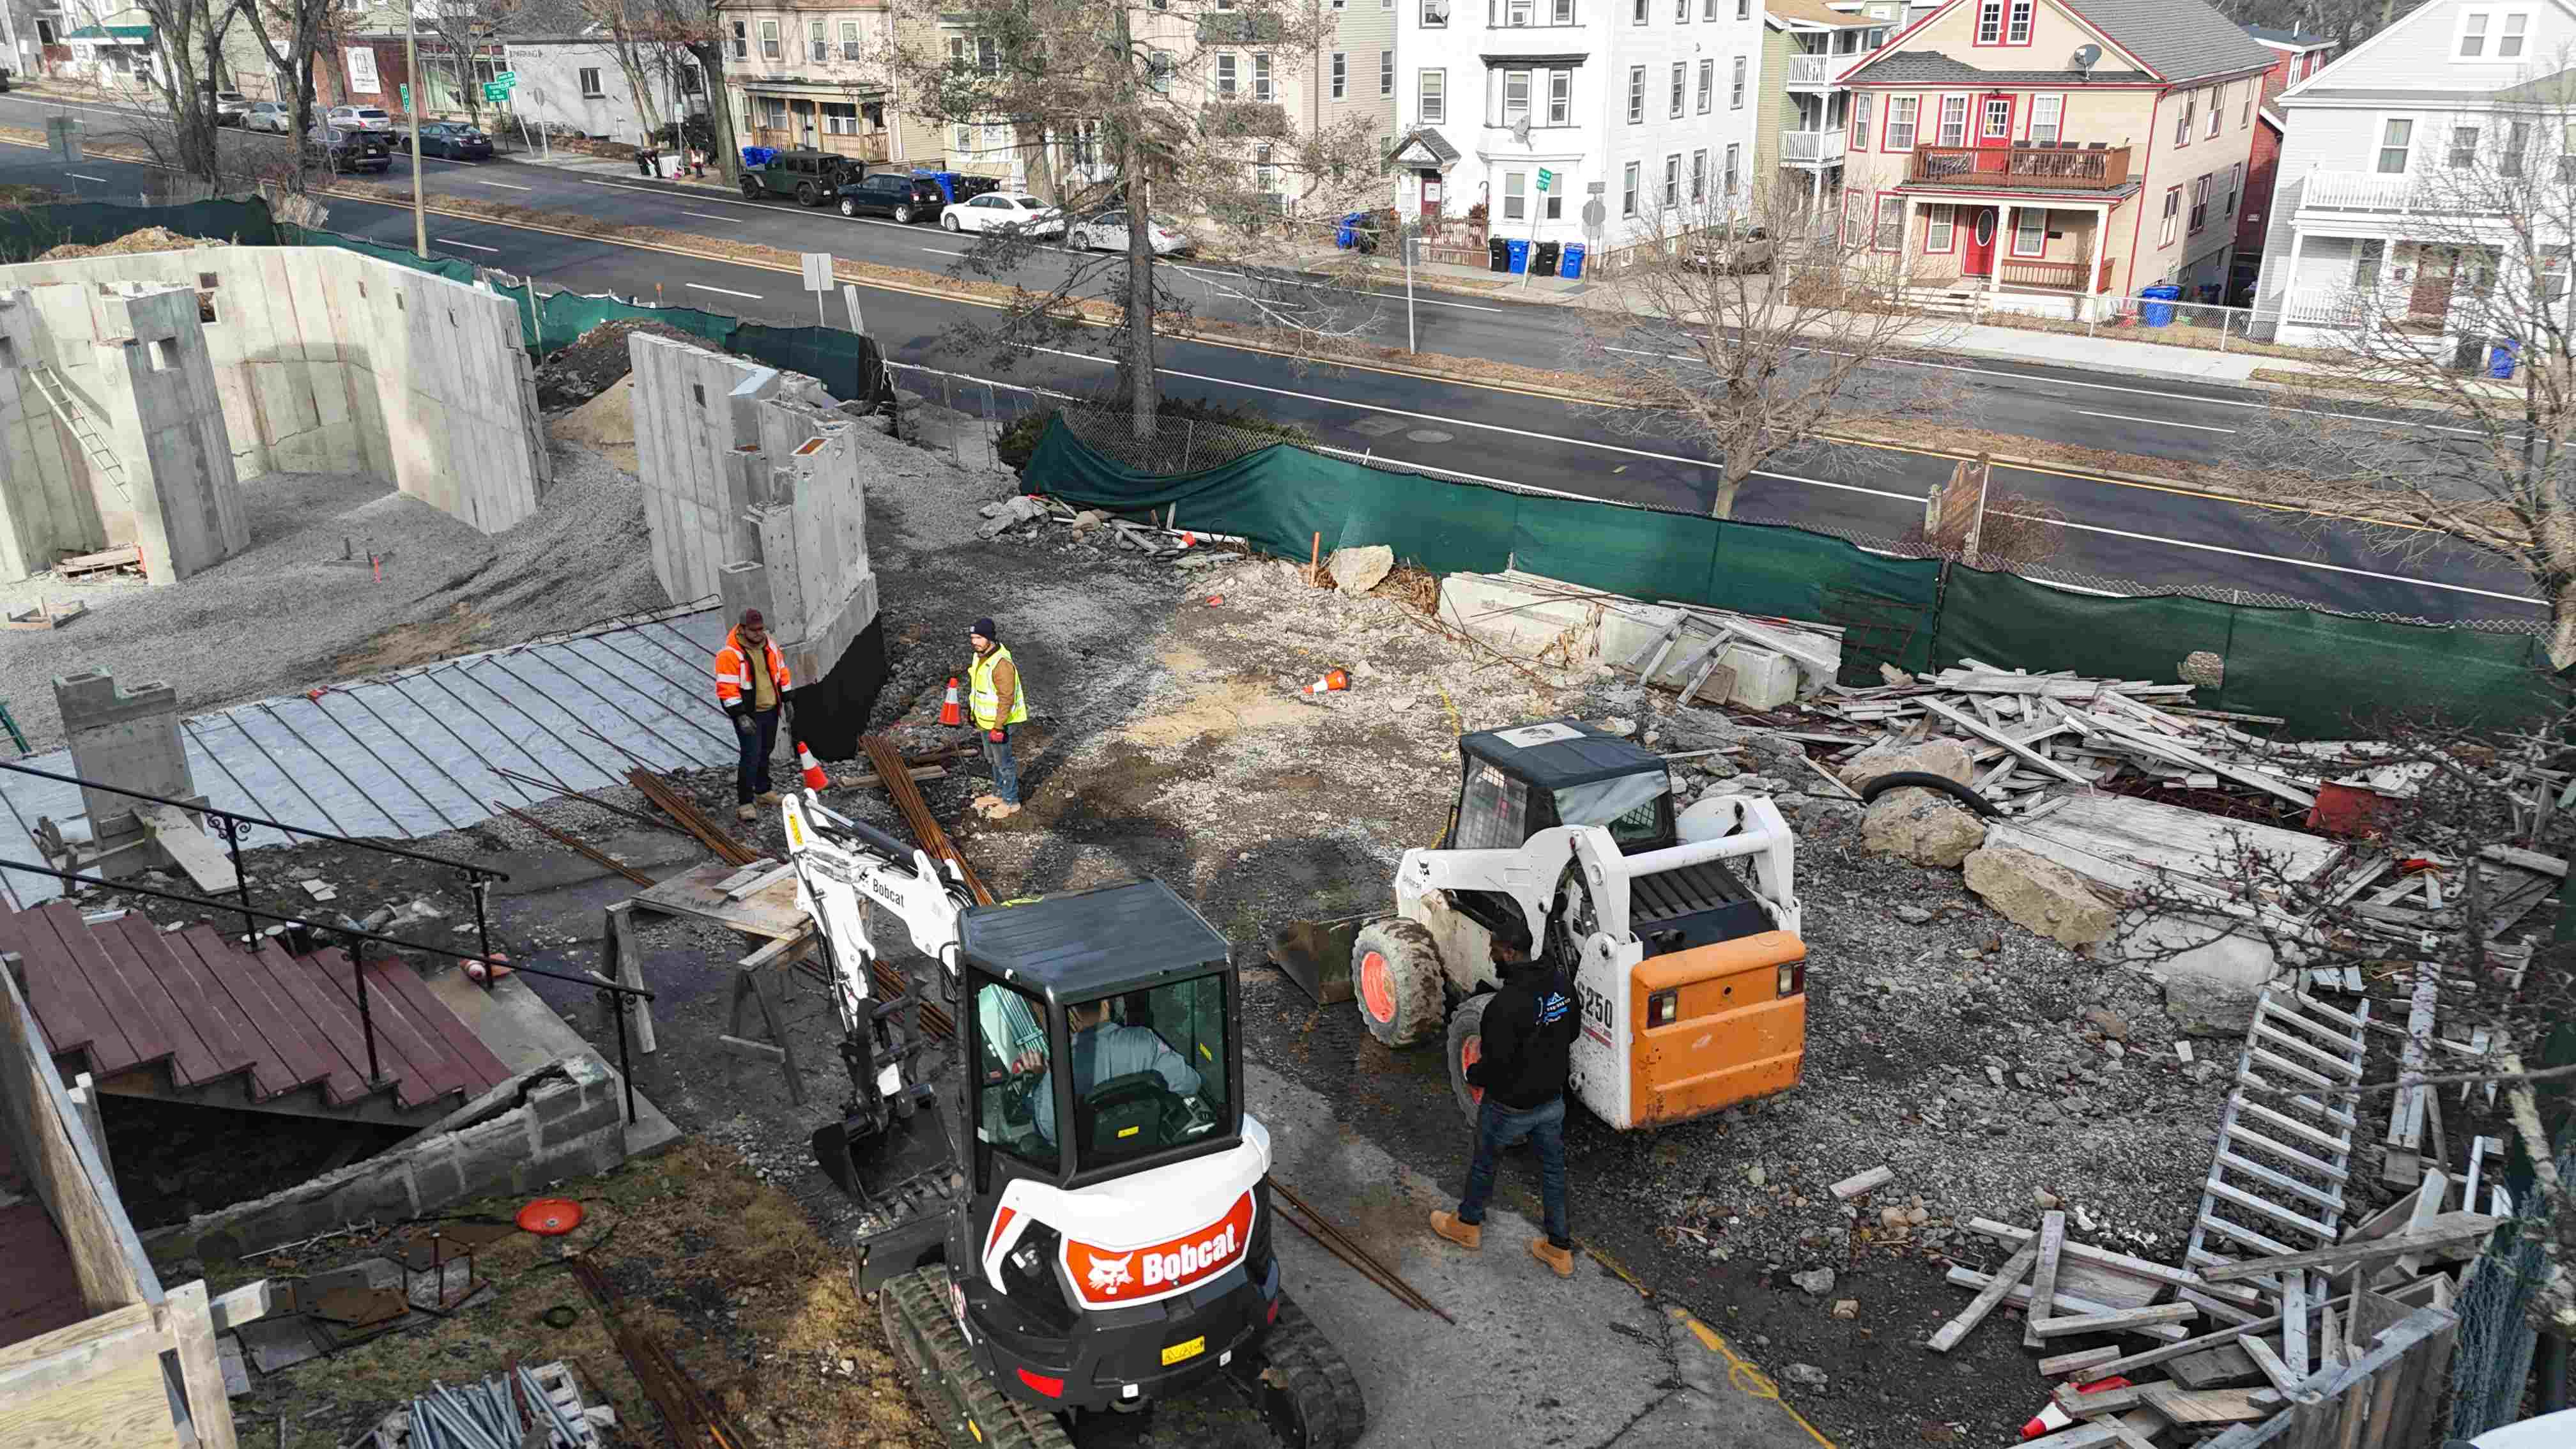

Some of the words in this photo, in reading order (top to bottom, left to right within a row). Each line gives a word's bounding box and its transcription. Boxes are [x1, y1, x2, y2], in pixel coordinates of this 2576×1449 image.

[873, 878, 905, 908] Bobcat
[1576, 981, 1613, 1029] S250
[1142, 1223, 1236, 1286] Bobcat
